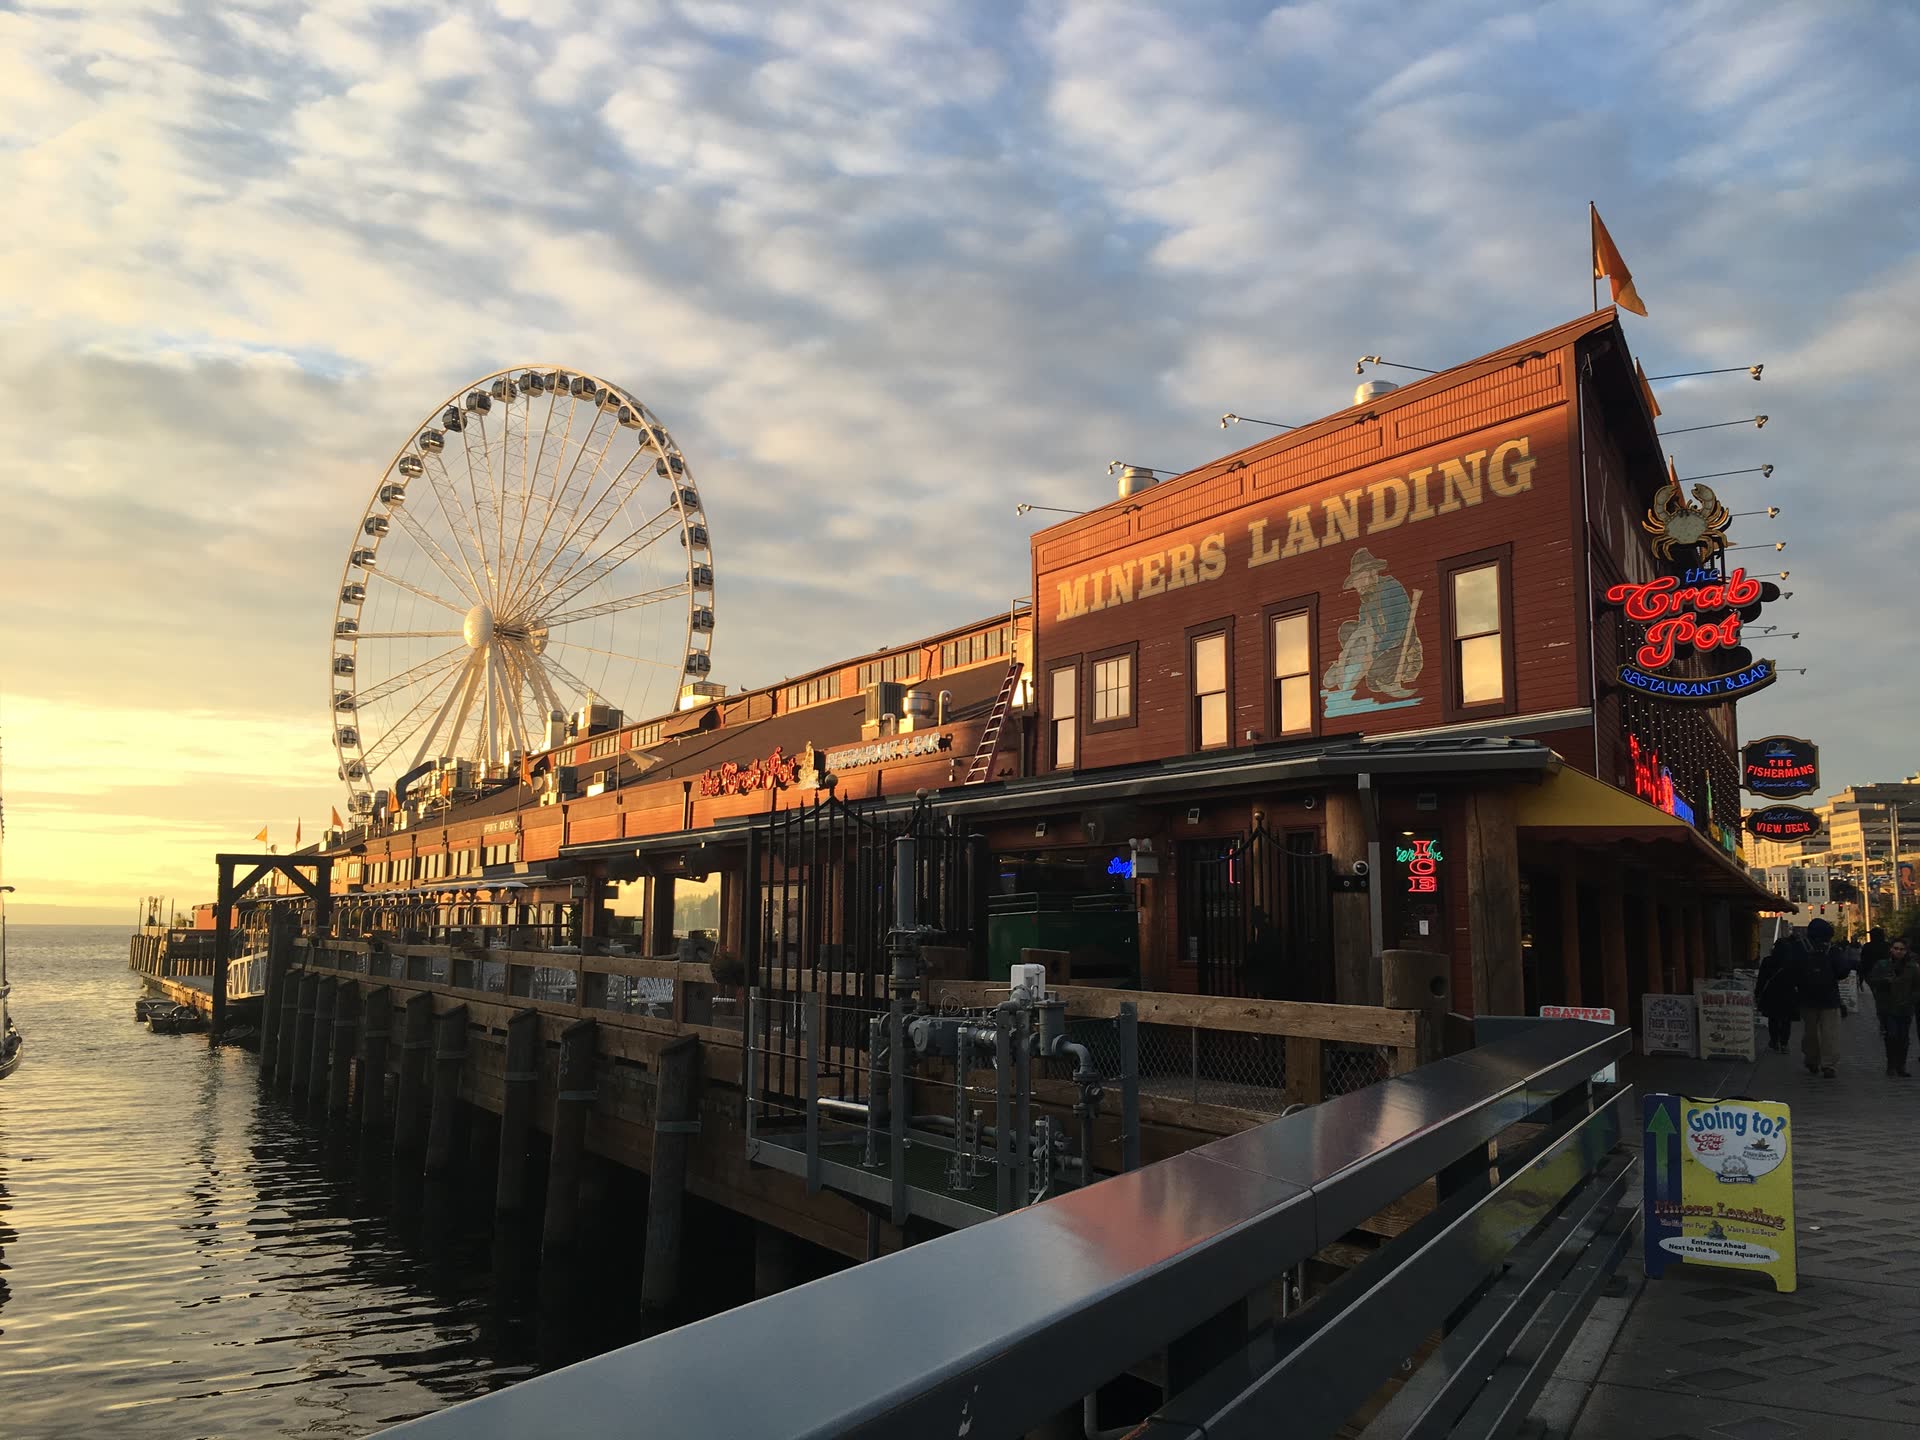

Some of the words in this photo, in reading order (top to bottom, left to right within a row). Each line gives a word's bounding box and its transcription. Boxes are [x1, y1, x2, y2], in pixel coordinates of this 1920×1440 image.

[1056, 532, 1227, 622] MINERS
[1247, 436, 1536, 568] LANDING
[1685, 567, 1719, 583] the
[1607, 567, 1761, 621] Crab
[1637, 610, 1742, 669] Pot
[1620, 667, 1721, 697] RESTAURANT
[1726, 673, 1740, 690] &
[1738, 663, 1770, 686] BAR
[762, 745, 796, 790] Pot
[1747, 763, 1816, 779] FISHERMANS
[1768, 759, 1793, 767] THE
[1763, 811, 1803, 821] Outdoor
[1756, 822, 1783, 834] VIEW
[1784, 822, 1811, 834] DECK
[1542, 1006, 1611, 1021] SEATTLE
[1687, 1105, 1747, 1137] Going
[1752, 1112, 1788, 1139] to?
[1717, 1201, 1786, 1231] Landing
[1668, 1243, 1685, 1251] Next
[1708, 1248, 1733, 1256] Seattle
[1734, 1250, 1771, 1260] Aquarium
[1691, 1238, 1722, 1248] Entrance
[1723, 1242, 1747, 1250] Ahead
